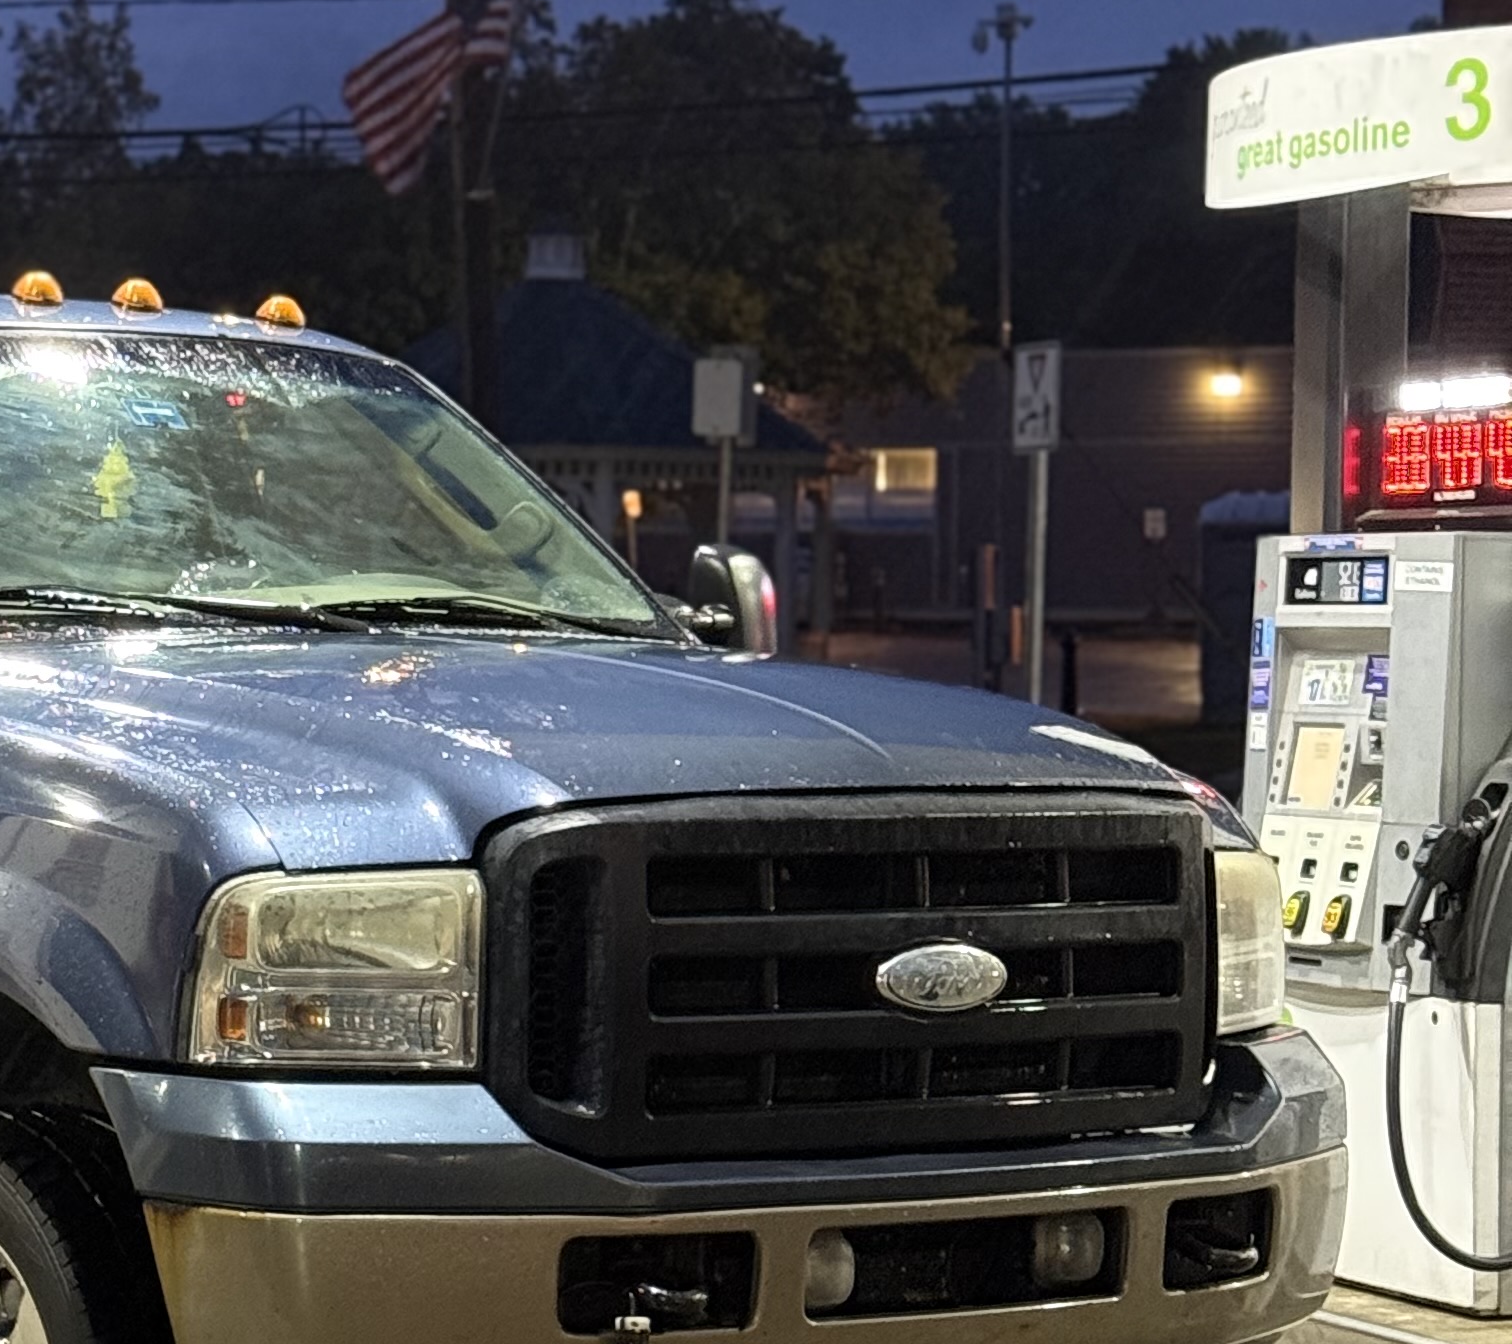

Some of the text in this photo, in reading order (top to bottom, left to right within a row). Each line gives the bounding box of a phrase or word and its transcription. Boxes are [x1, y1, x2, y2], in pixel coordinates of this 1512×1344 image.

[1445, 57, 1491, 142] 3
[1237, 116, 1410, 180] great gasoline
